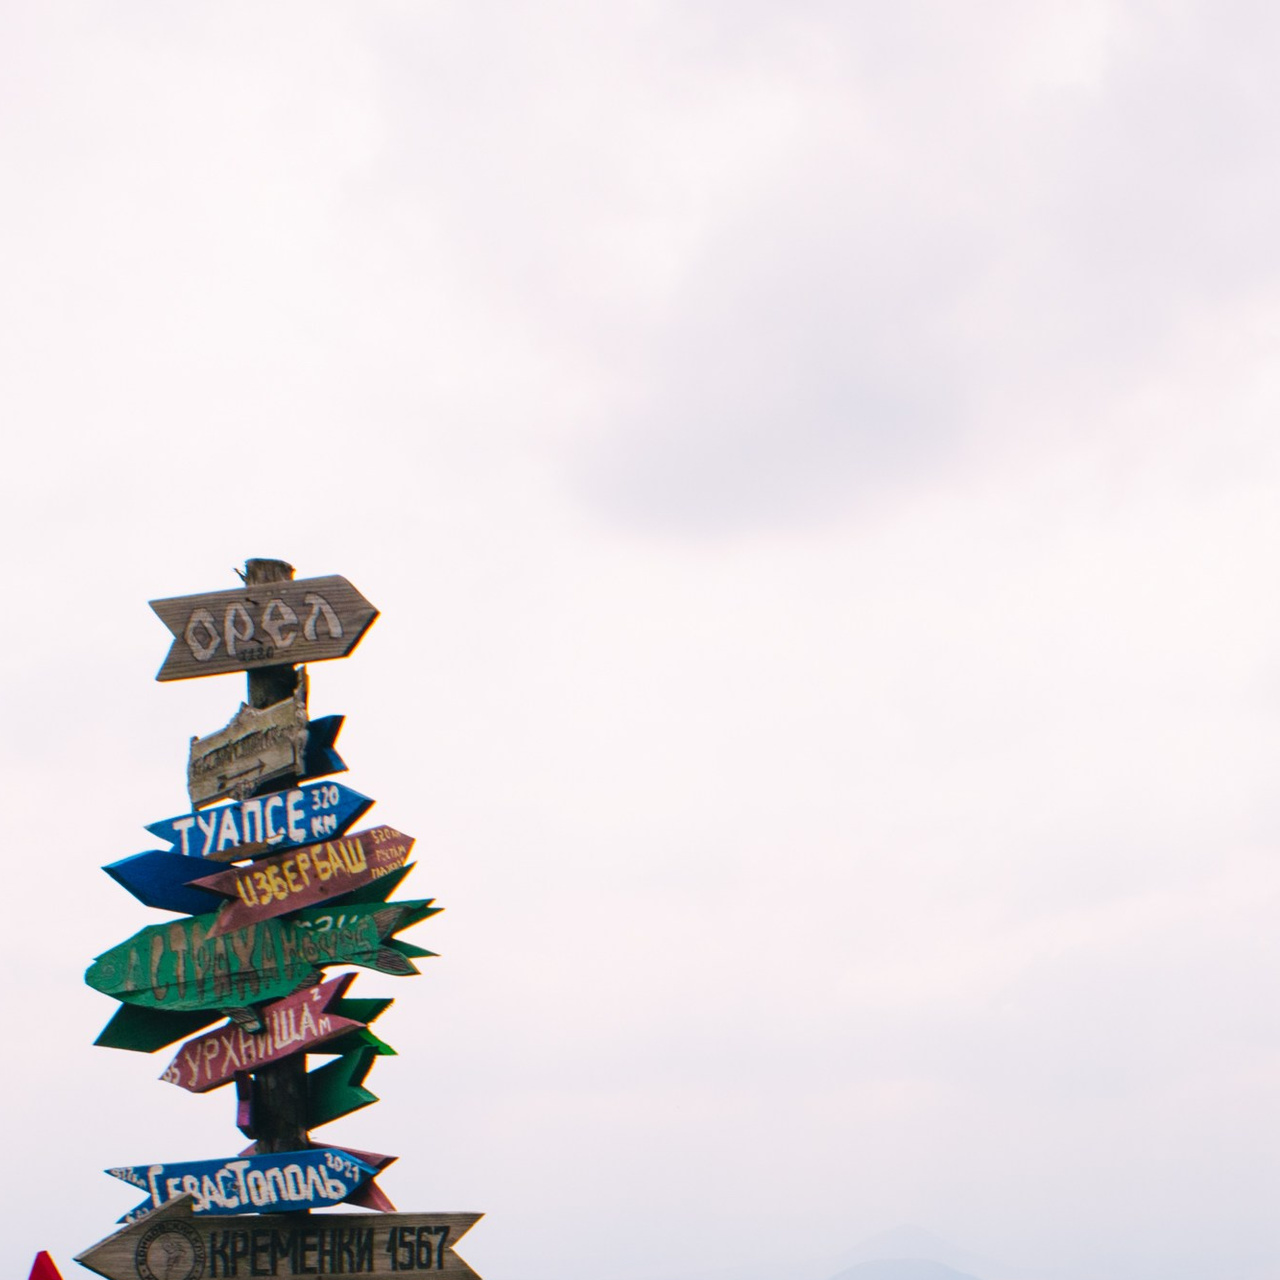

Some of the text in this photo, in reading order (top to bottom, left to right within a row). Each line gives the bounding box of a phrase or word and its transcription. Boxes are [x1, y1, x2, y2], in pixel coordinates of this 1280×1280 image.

[172, 790, 307, 857] ТУАПСЕ
[311, 785, 340, 811] 320
[235, 837, 369, 908] ИЗБЕРБАШ
[209, 1226, 451, 1279] КРЕМЕНКИ 1567
